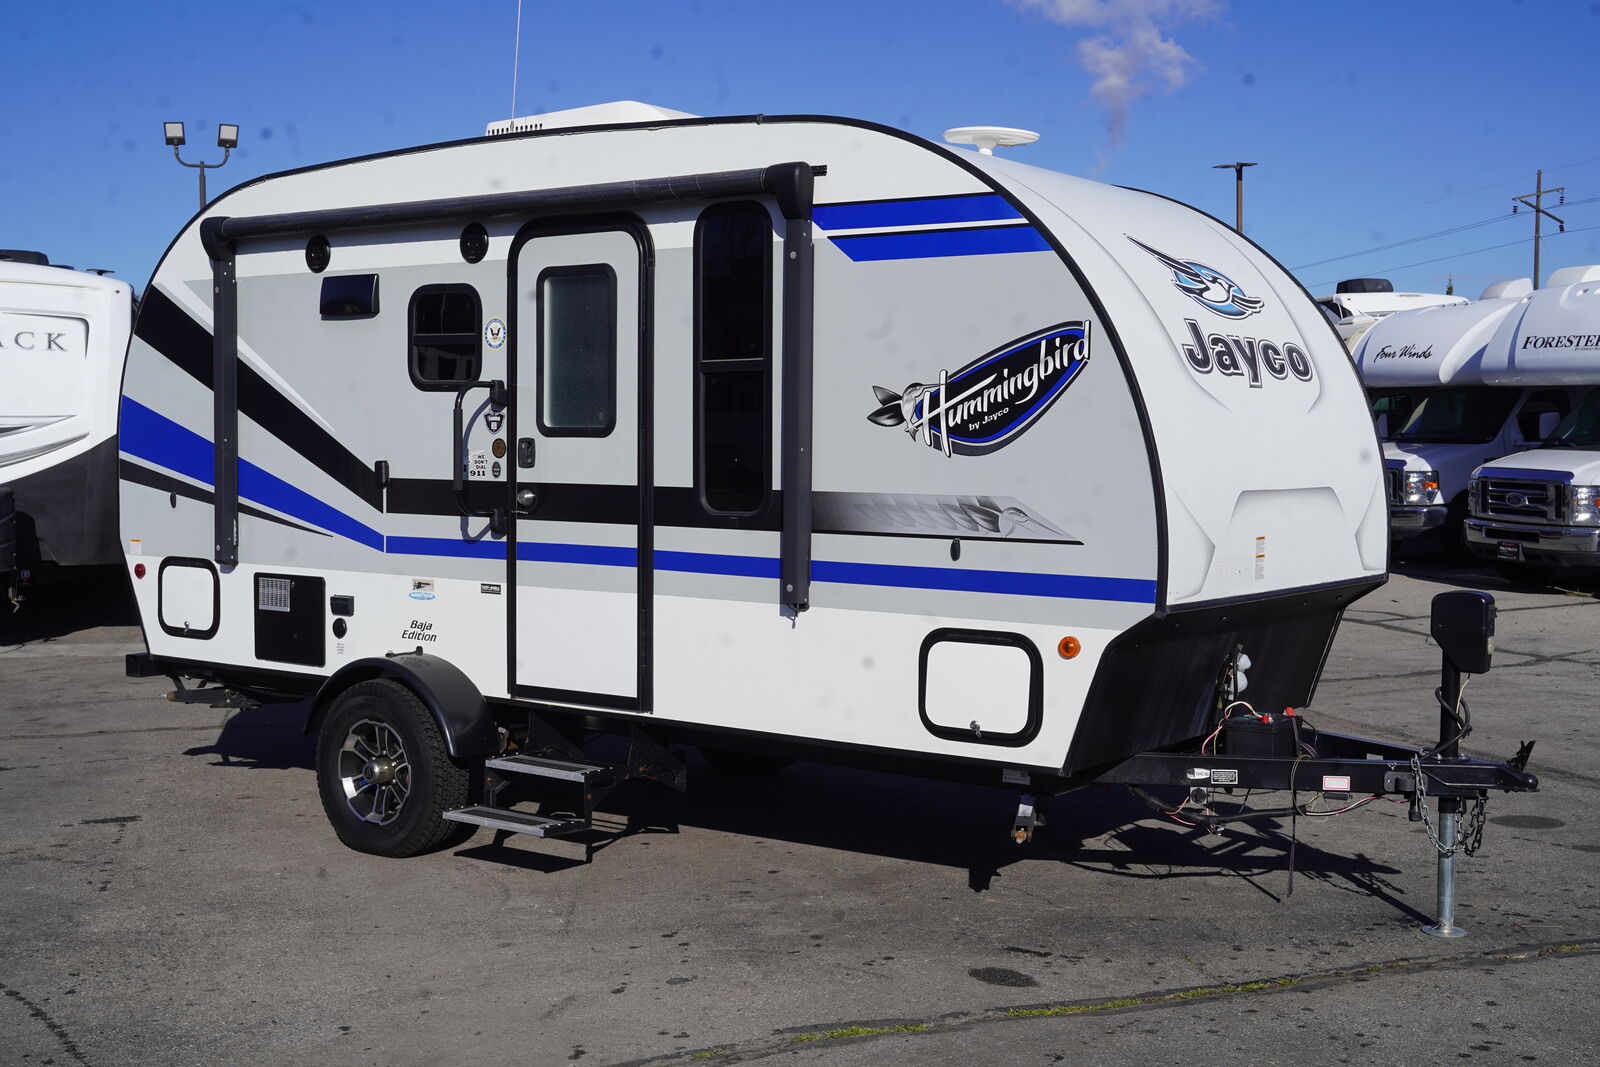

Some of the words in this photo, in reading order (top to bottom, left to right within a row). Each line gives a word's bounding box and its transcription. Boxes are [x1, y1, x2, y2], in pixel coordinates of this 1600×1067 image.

[1182, 318, 1313, 388] Jayco
[1374, 346, 1397, 363] Four
[1398, 343, 1433, 360] Winds
[907, 320, 1091, 458] Hummingbird
[969, 422, 980, 432] by
[982, 407, 1009, 425] Jayco
[402, 630, 437, 642] Edition
[410, 619, 433, 631] Baja
